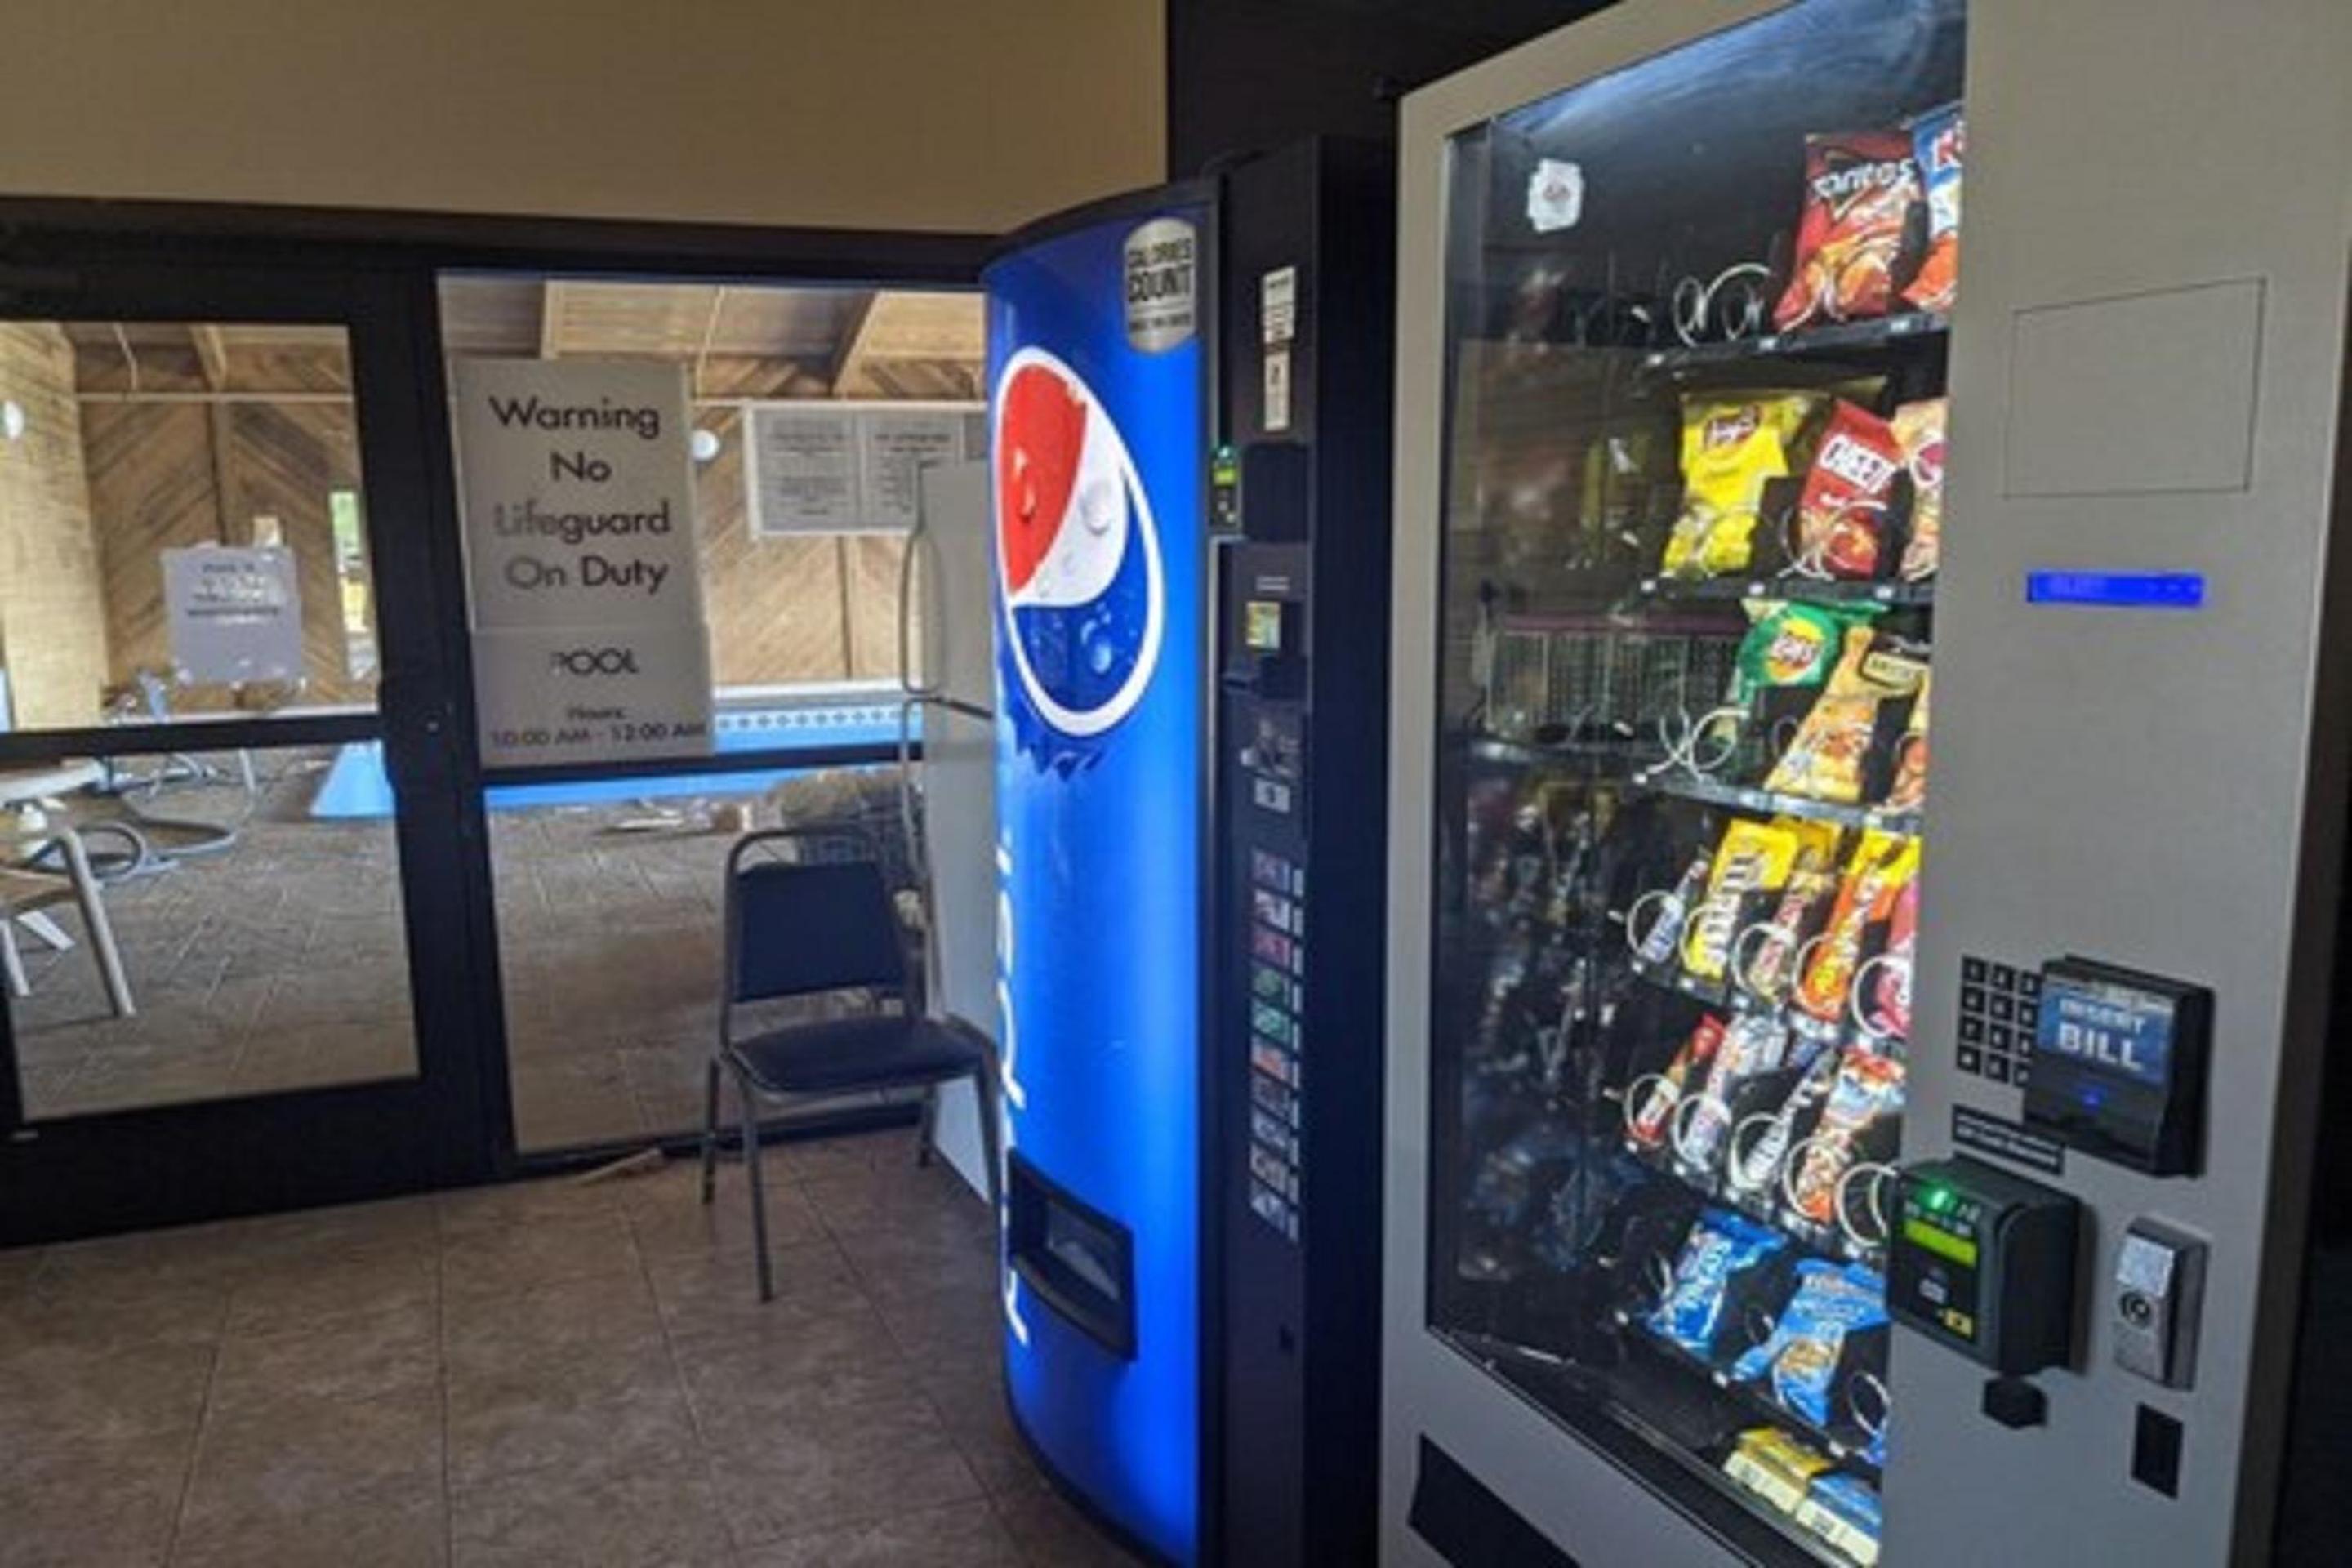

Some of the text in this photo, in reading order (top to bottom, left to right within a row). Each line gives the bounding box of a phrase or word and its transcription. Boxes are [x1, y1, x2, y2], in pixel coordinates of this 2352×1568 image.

[489, 395, 660, 440] Warning
[550, 451, 612, 483] No
[493, 498, 671, 545] Lifeguard
[504, 554, 670, 594] On Duty
[550, 648, 639, 676] POOL
[2059, 997, 2146, 1036] INSERT
[2059, 1021, 2145, 1072] BILL
